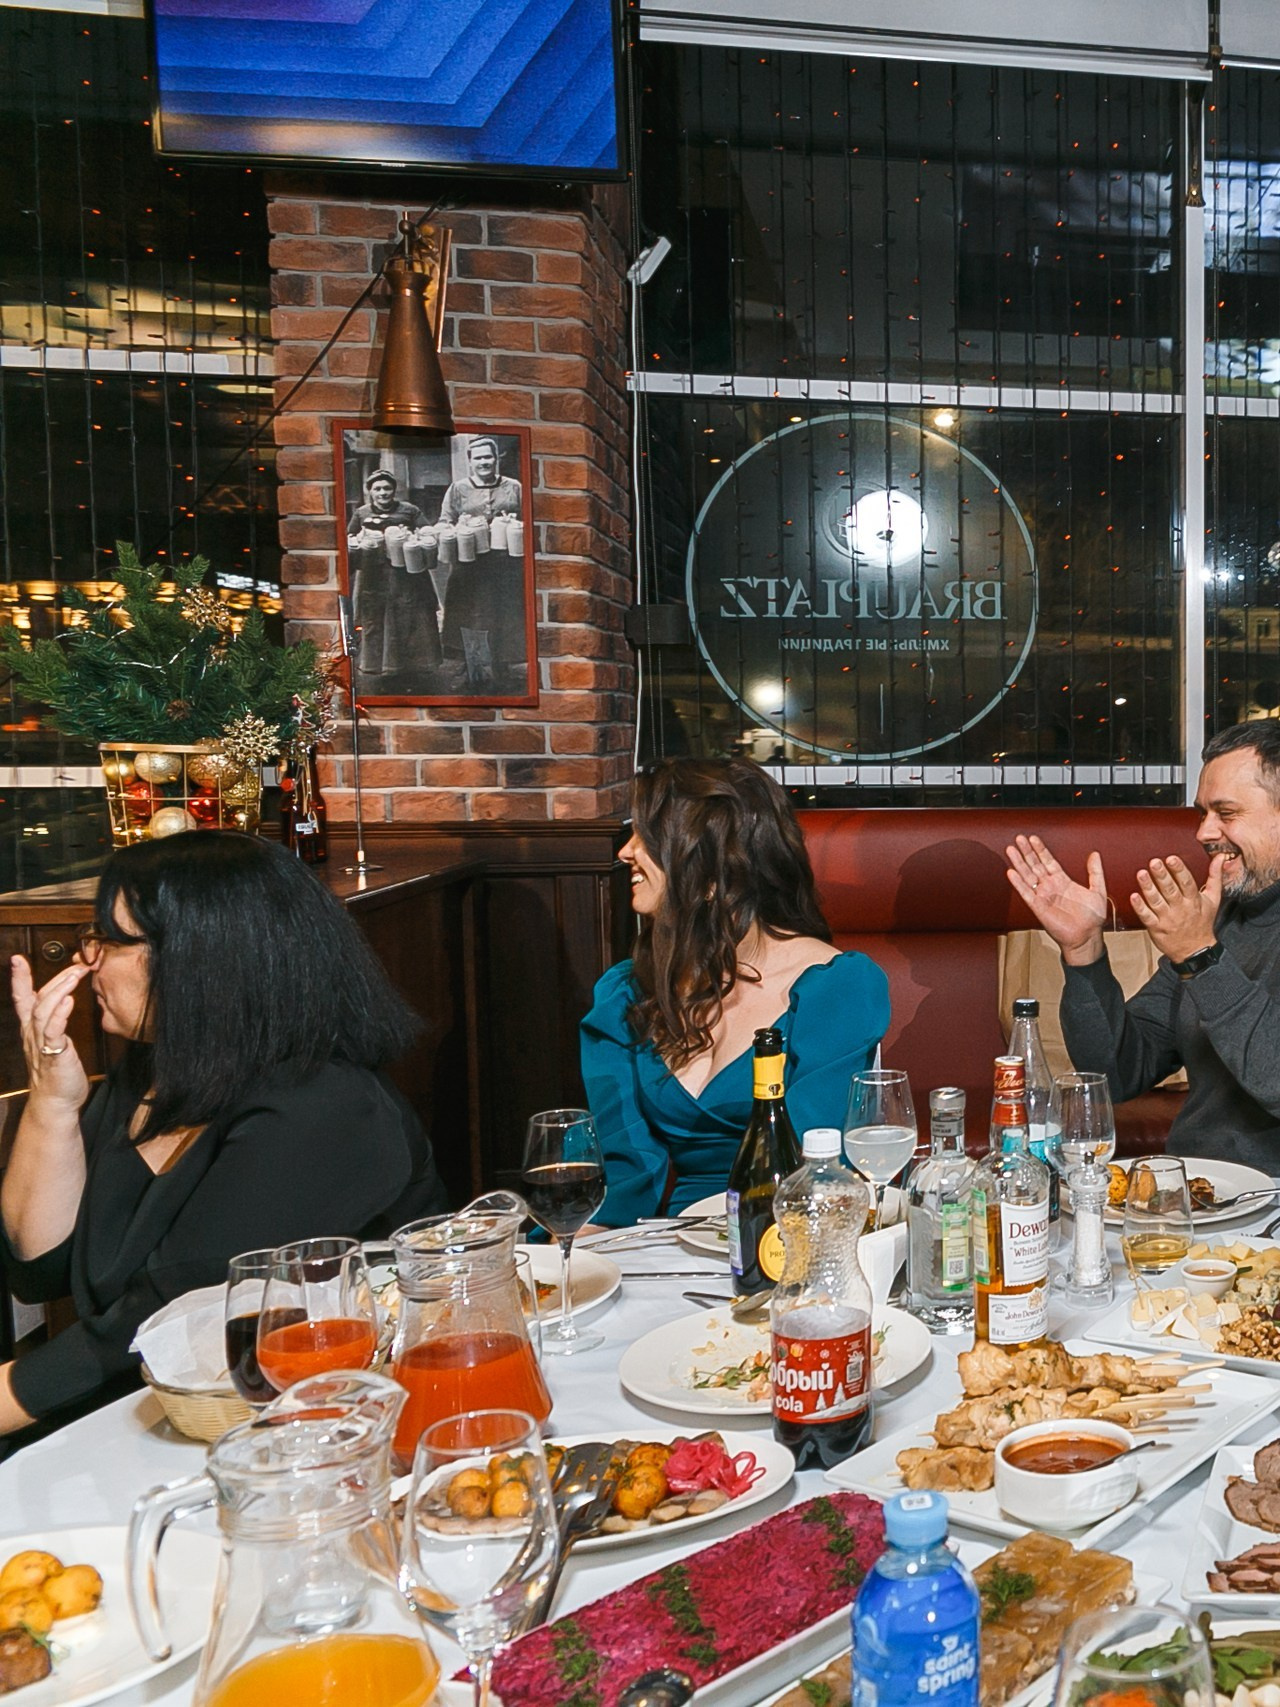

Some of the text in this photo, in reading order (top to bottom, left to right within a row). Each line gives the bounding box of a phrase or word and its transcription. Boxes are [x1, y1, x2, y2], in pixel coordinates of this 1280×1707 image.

[776, 1395, 804, 1413] cola
[924, 1642, 971, 1675] saint
[917, 1656, 976, 1697] spring
